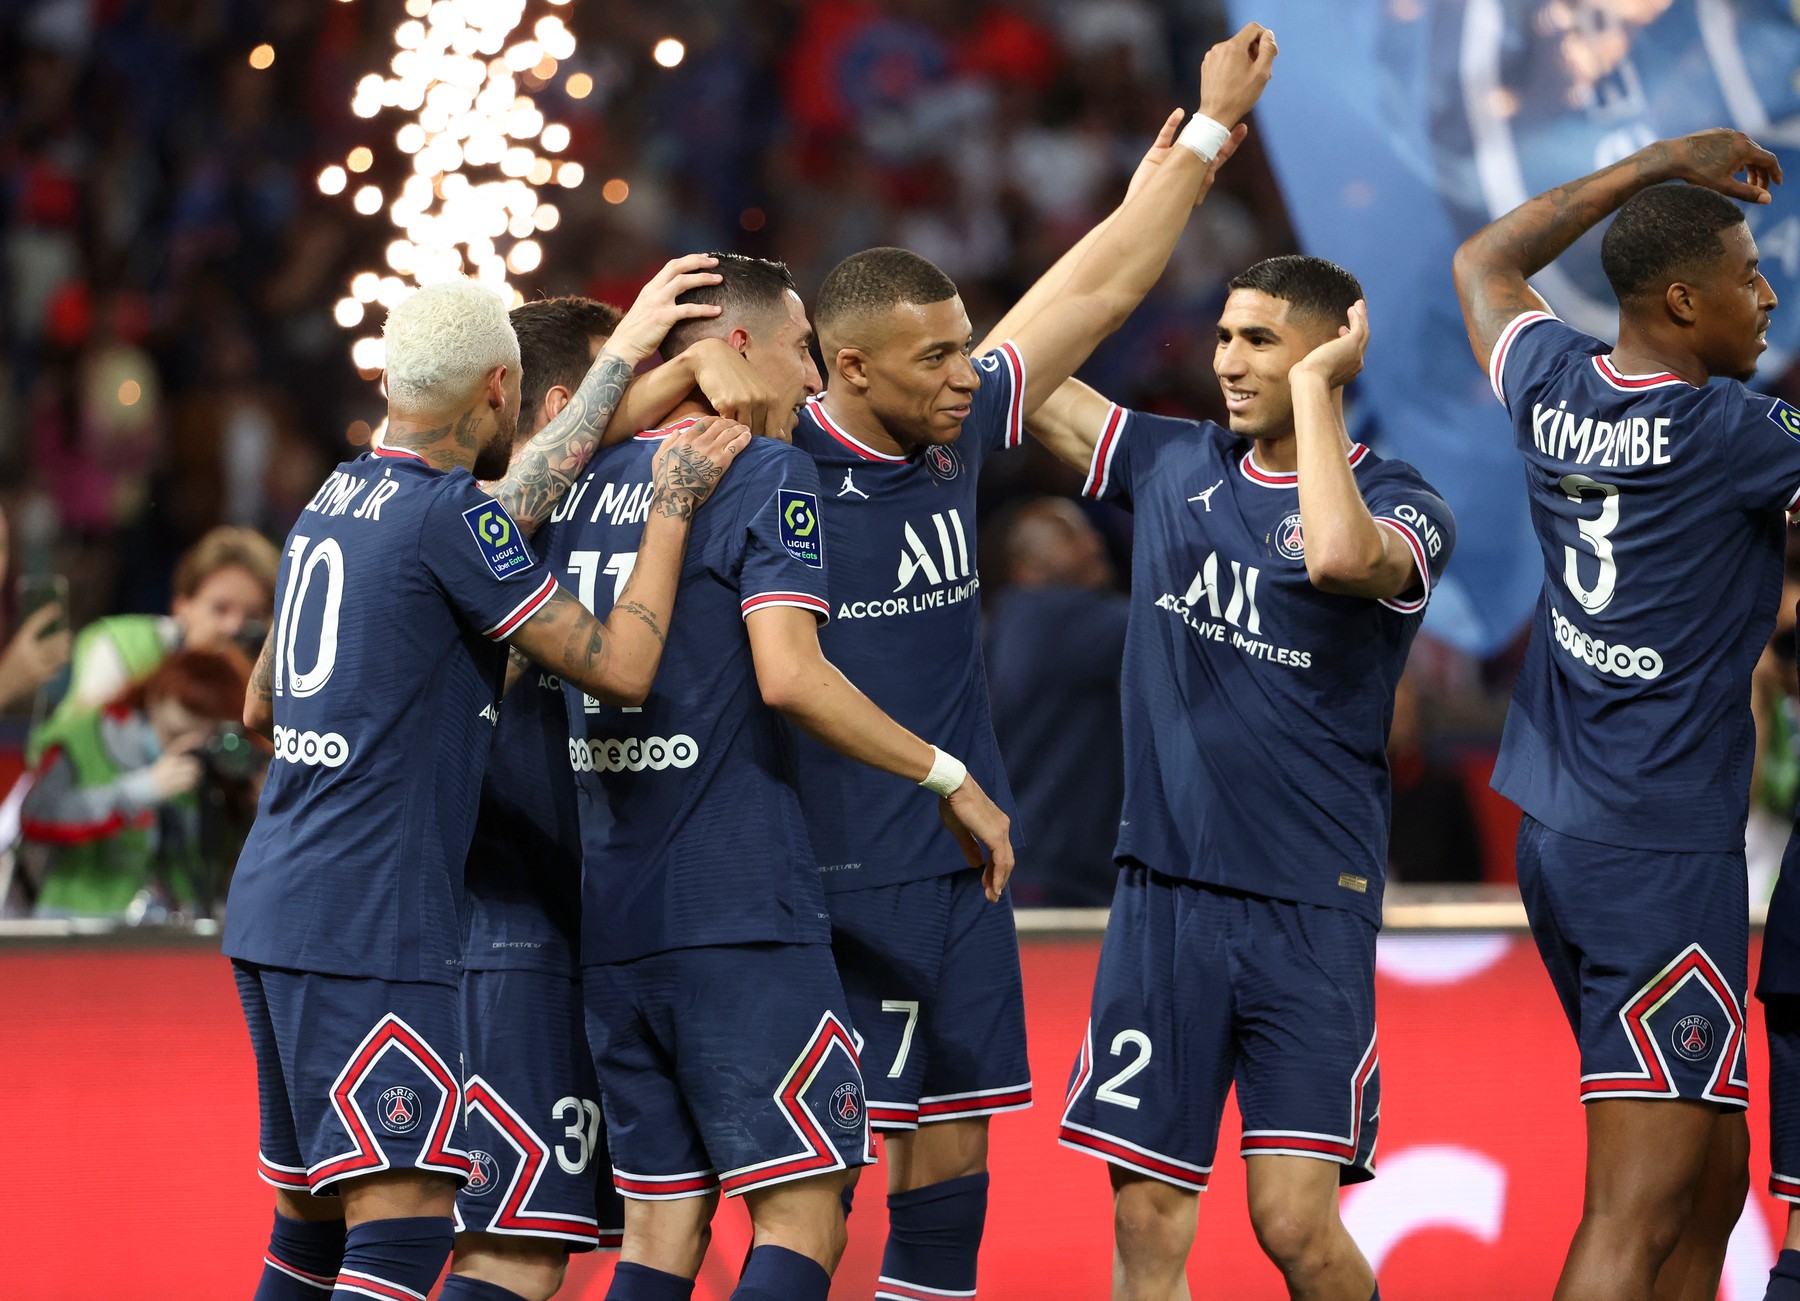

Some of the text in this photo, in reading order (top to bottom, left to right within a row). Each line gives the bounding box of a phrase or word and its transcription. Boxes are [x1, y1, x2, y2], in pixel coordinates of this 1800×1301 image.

[590, 481, 655, 526] MAR
[787, 540, 811, 549] LIGUE
[1394, 504, 1442, 558] QNB
[1559, 474, 1620, 615] 3
[491, 547, 515, 563] LIGUE
[508, 555, 525, 566] Eats
[801, 551, 818, 560] Eats
[275, 535, 345, 698] 10
[837, 578, 980, 619] ACCOR LIVE LIMIT
[1228, 632, 1312, 669] IMITLESS
[568, 733, 699, 773] ooredoo
[881, 1000, 919, 1078] 7
[1680, 1017, 1709, 1030] PARIS
[1095, 1029, 1152, 1110] 2
[383, 1088, 415, 1101] PARIS
[834, 1084, 857, 1099] PARIS
[469, 1152, 492, 1165] ARIS
